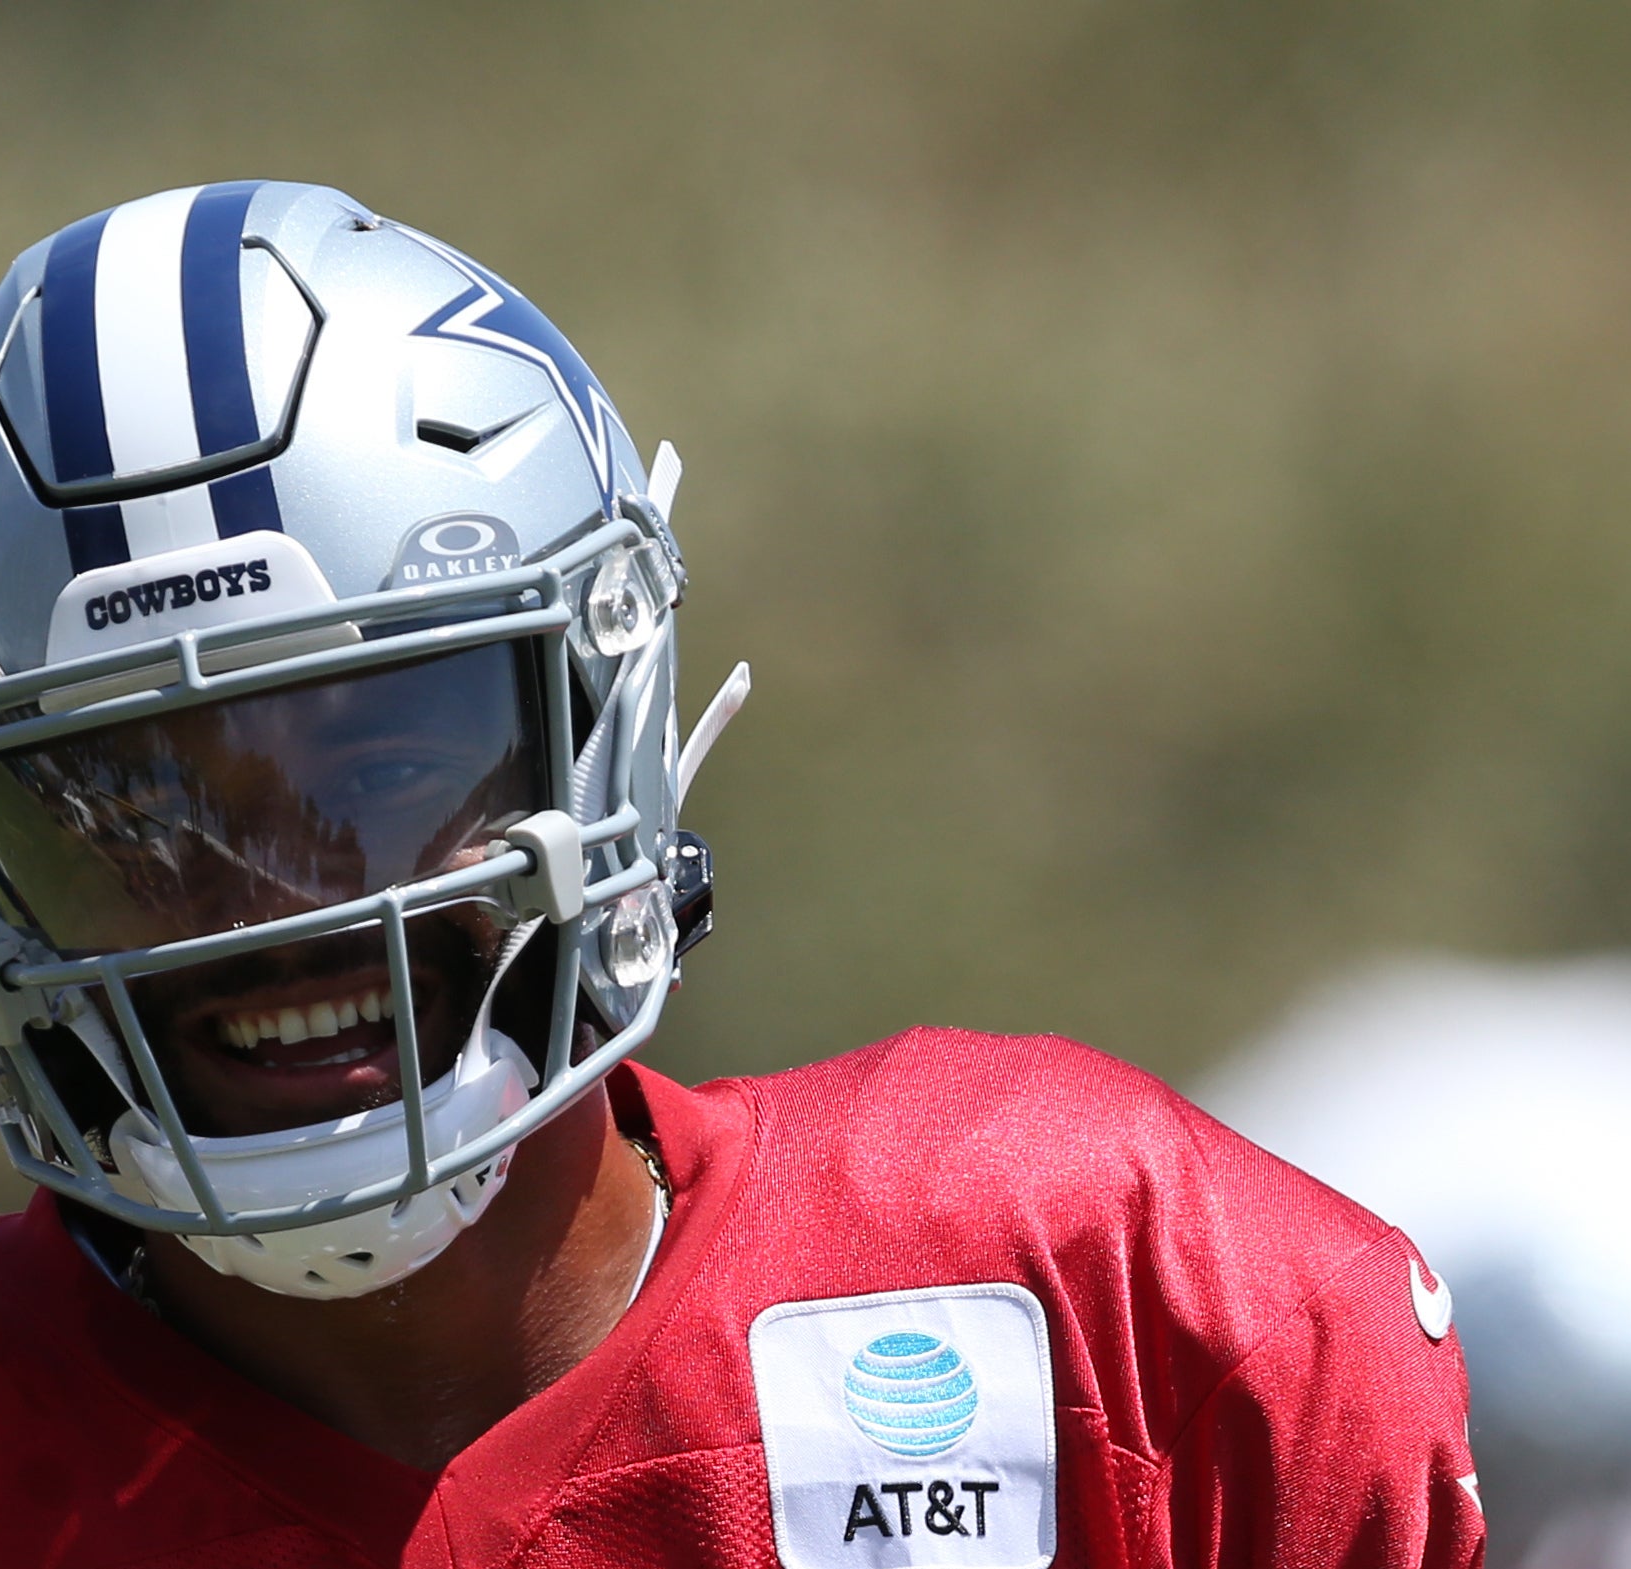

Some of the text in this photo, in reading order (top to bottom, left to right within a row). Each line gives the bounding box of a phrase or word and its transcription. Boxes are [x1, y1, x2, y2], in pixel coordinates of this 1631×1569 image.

[85, 559, 271, 630] COWBOYS
[403, 554, 514, 580] OAKLEY
[844, 1480, 999, 1543] AT&T
